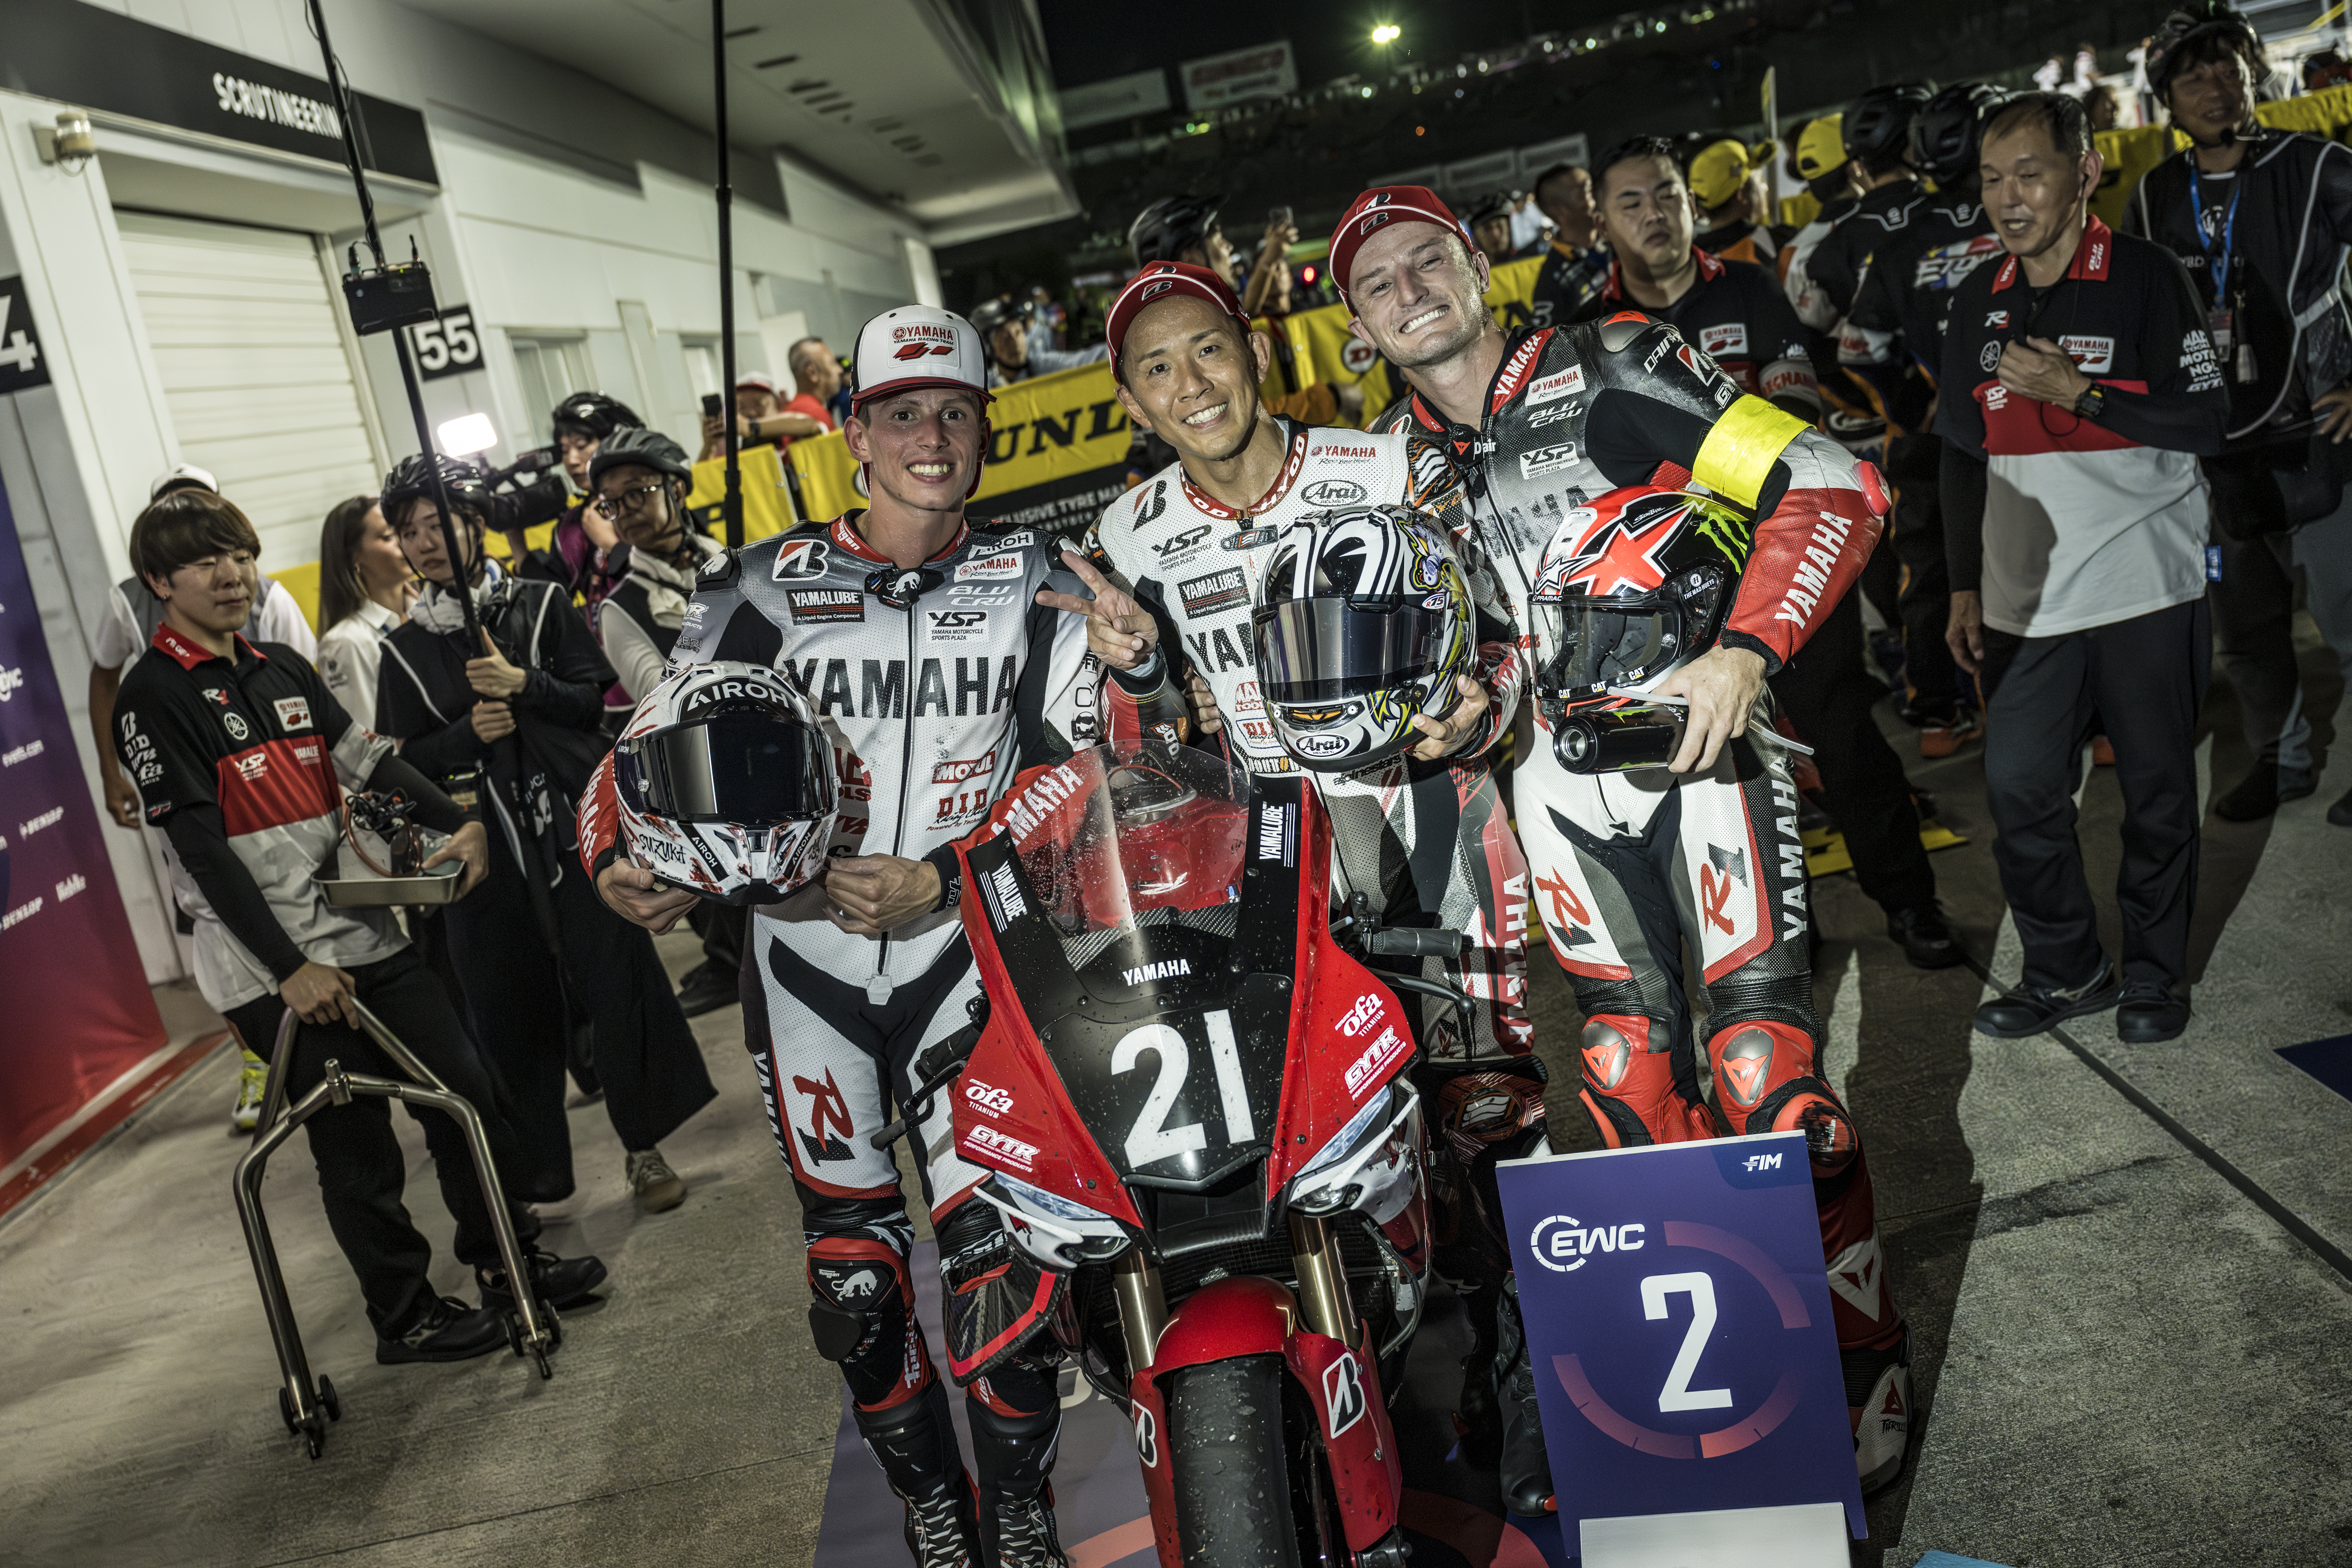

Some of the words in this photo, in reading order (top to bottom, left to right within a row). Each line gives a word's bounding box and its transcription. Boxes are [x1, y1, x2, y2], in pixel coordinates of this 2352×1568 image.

[213, 72, 342, 140] SCRUTINEERIN
[414, 314, 478, 370] 55
[907, 326, 953, 340] YAMAHA
[2074, 340, 2109, 350] YAMAHA
[1495, 335, 1541, 396] YAMAHA
[1542, 371, 1579, 390] YAMAHA
[1984, 386, 2007, 402] YSP
[1527, 401, 1578, 421] BLU
[1530, 408, 1583, 428] CRU
[1325, 446, 1376, 457] YAMAHA
[1521, 443, 1574, 466] YSP
[1546, 457, 1574, 469] MOTORCYCLE
[1528, 469, 1546, 478] SPORTS
[1546, 466, 1561, 475] PLAZA
[1305, 482, 1360, 500] Arai
[1151, 524, 1211, 557] YSP
[973, 558, 1017, 570] YAMAHA
[1159, 553, 1180, 566] YAMAHA
[1180, 543, 1212, 557] MOTORCYCLE
[1162, 561, 1179, 572] SPORTS
[1180, 555, 1196, 565] PLAZA
[1774, 512, 1853, 629] YAMAHA
[946, 585, 1011, 595] BLU
[1182, 572, 1242, 598] YAMALUBE
[1684, 591, 1692, 600] THE
[1692, 586, 1702, 595] MAD
[1701, 578, 1715, 591] HUEYS
[791, 591, 859, 607] YAMALUBE
[950, 595, 1016, 606] CRU
[1194, 606, 1207, 615] Liquid
[1207, 603, 1221, 612] Engine
[1221, 597, 1246, 608] Component
[1426, 597, 1444, 607] R75
[928, 612, 987, 627] YSP
[1628, 666, 1644, 679] CAT
[687, 681, 790, 711] AIROH
[783, 655, 1016, 719] YAMAHA
[1559, 689, 1571, 698] CAT
[1591, 681, 1607, 694] CAT
[618, 745, 629, 753] AIROH
[1300, 736, 1344, 751] Arai
[27, 806, 64, 835] DUNLOP
[1260, 804, 1283, 859] YAMALUBE
[639, 834, 686, 865] SUZUKA
[691, 836, 718, 868] AIROH
[792, 832, 811, 865] AIROH
[1771, 757, 1807, 941] YAMAHA
[992, 860, 1025, 922] YAMALUBE
[3, 896, 43, 930] DUNLOP
[1122, 959, 1191, 986] YAMAHA
[1344, 993, 1383, 1037] ofa
[1358, 1009, 1385, 1037] TITANIUM
[1345, 1027, 1398, 1090] GYTR
[1352, 1064, 1384, 1101] PERFORMANCE
[1384, 1041, 1406, 1067] PRODUCTS
[966, 1086, 1014, 1113] ofa
[1111, 1009, 1256, 1169] 21
[969, 1101, 999, 1119] TITANIUM
[969, 1124, 1038, 1161] GYTR
[963, 1140, 1002, 1160] PERFORMANCE
[1001, 1156, 1033, 1173] PRODUCTS
[1743, 1153, 1783, 1171] FIM
[1551, 1224, 1645, 1257] EWC
[1640, 1272, 1733, 1412] 2
